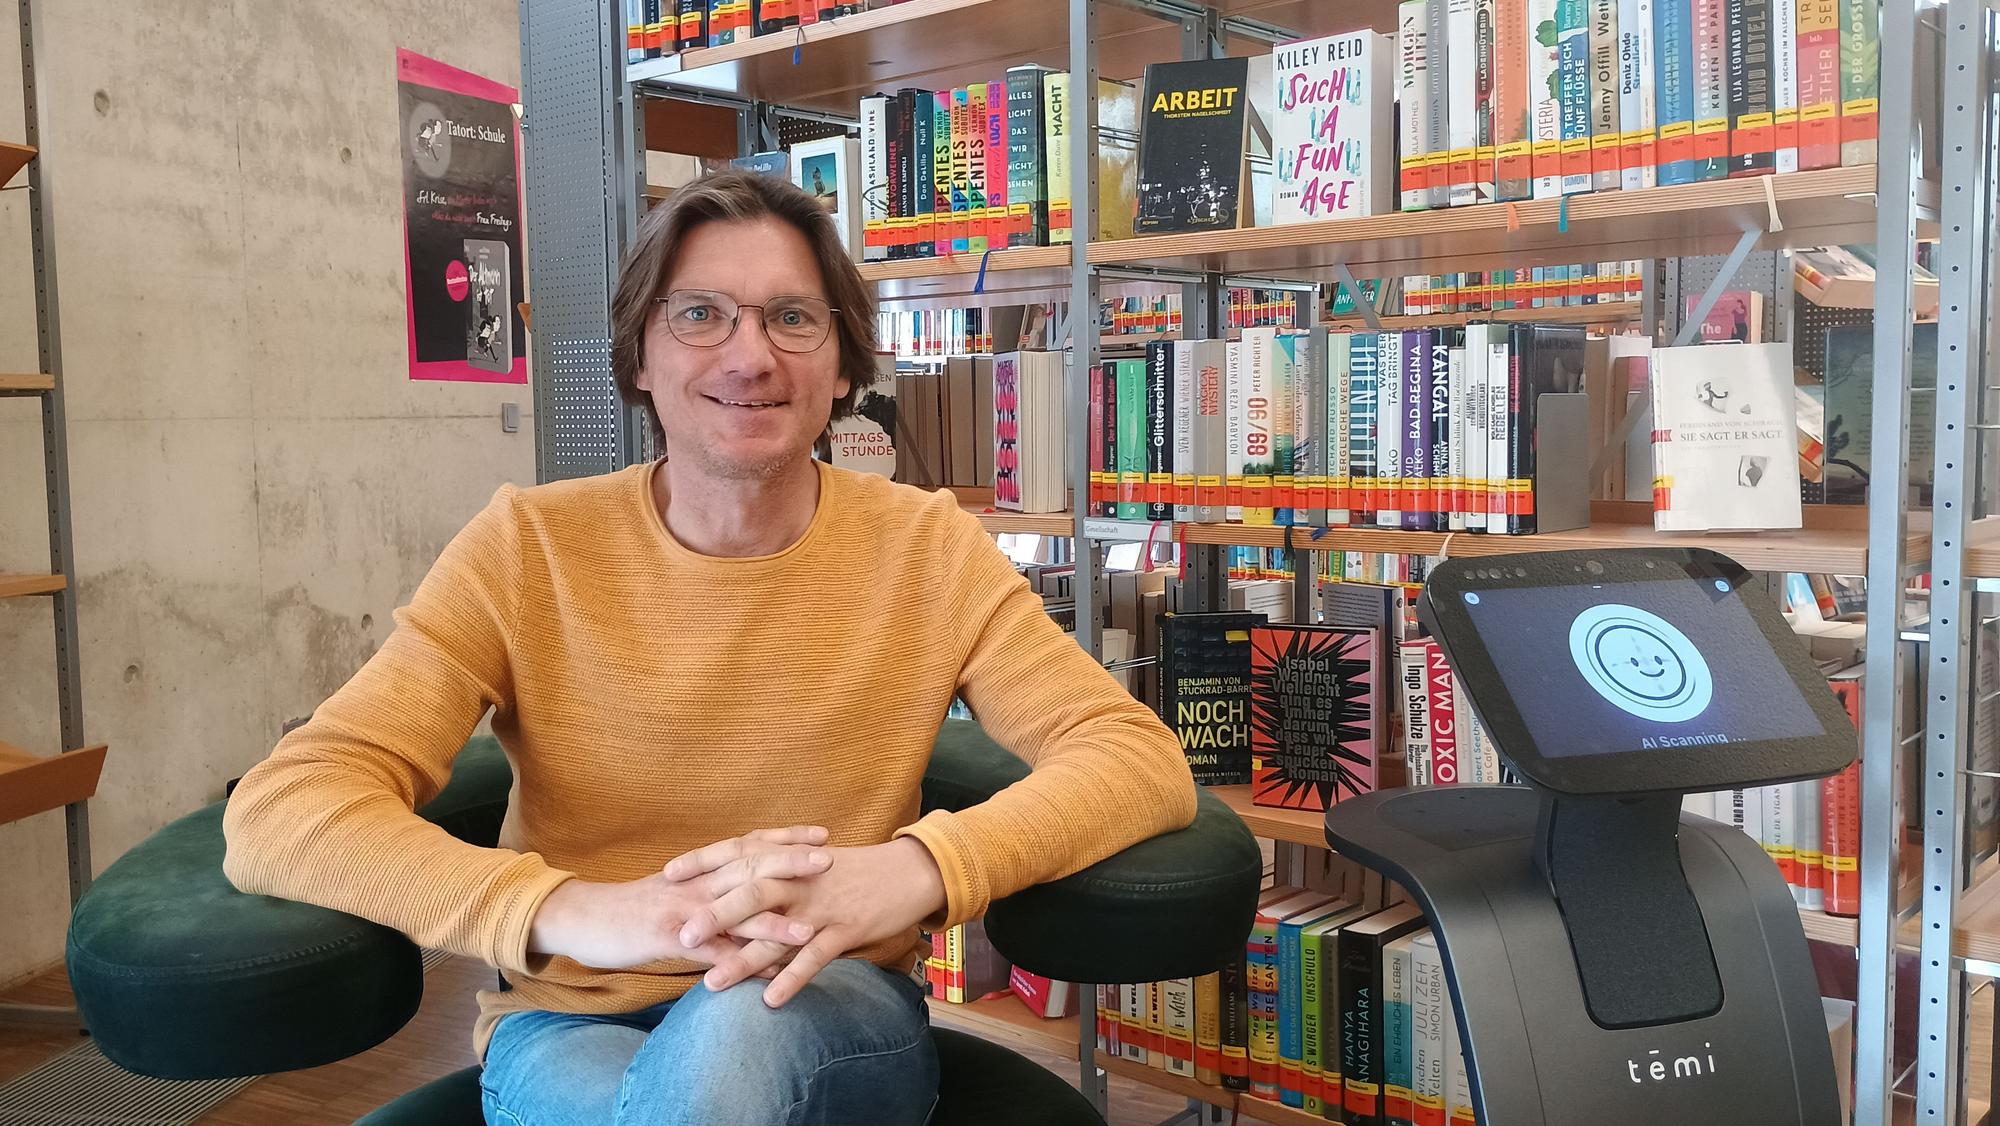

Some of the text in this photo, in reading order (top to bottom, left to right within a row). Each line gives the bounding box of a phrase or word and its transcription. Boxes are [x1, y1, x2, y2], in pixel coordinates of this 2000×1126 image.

[1277, 38, 1364, 71] KILEY REID
[1403, 17, 1415, 88] MORGEN
[1479, 13, 1488, 80] LADENHÜTERIN
[1598, 46, 1611, 83] Offill
[1622, 32, 1632, 95] Deniz Ohde
[1731, 29, 1742, 102] ILJA LEONARD
[1562, 42, 1573, 126] TREFFEN SICH
[1700, 42, 1709, 116] CHRISTOPH
[1709, 34, 1720, 109] KRÄHEN IM
[1801, 73, 1813, 106] TILL
[1852, 58, 1864, 84] DER
[1008, 92, 1033, 101] ALLES
[1008, 109, 1033, 119] LICHT
[1051, 85, 1063, 137] MACHT
[1151, 86, 1238, 113] ARBEIT
[1573, 58, 1586, 139] FÜNF FLÜSSE
[1599, 89, 1614, 130] Jenny
[446, 119, 507, 144] Tatort: Schule
[1011, 128, 1028, 136] DAS
[1319, 105, 1340, 144] A
[868, 138, 877, 185] ASHLAND
[888, 140, 897, 198] VORWEINER
[1011, 145, 1028, 154] WIR
[1300, 177, 1355, 215] AGE
[1700, 323, 1722, 336] The
[1378, 335, 1387, 389] WAS DER
[1388, 335, 1398, 407] TAG BRINGT
[1409, 345, 1421, 404] REGINA
[1153, 347, 1165, 447] Glitterschnitter
[1177, 350, 1191, 454] SVEN REGENER WIENER STRASSE
[1199, 368, 1209, 416] MAGICAL
[1208, 366, 1219, 416] MYSTERY
[1229, 346, 1239, 456] YASMINA REZA BABYLON
[1246, 335, 1268, 457] 89/90 PETER RICHTER
[1339, 371, 1348, 405] WEGE
[1432, 344, 1448, 422] KANGAL
[1295, 403, 1303, 441] Verfahren
[1409, 408, 1421, 440] BAD
[1495, 385, 1506, 441] REBELLEN
[829, 432, 884, 444] MITTAGS
[841, 445, 893, 457] STUNDE
[1440, 439, 1449, 464] ANNA
[1680, 430, 1750, 442] SIE ER
[1177, 676, 1241, 687] BENJAMIN VON
[1285, 655, 1329, 672] Isabel
[1272, 677, 1341, 697] Vielleicht
[1280, 694, 1333, 709] ging es
[1404, 664, 1429, 740] Ingo Schulze
[1177, 699, 1244, 725] NOCH
[1431, 653, 1456, 783] OXIC MAN
[1177, 724, 1248, 750] WACH
[1276, 728, 1308, 744] dass
[1286, 742, 1327, 758] Feuer
[1641, 731, 1729, 749] AI Scanning
[1186, 753, 1218, 766] OMAN
[1277, 754, 1337, 771] spucken
[1288, 765, 1338, 782] Roman
[1474, 756, 1483, 783] obert
[1264, 935, 1276, 1045] INTERESSANTEN
[1304, 947, 1316, 1003] UNSCHULD
[1392, 958, 1401, 991] LEBEN
[1392, 991, 1402, 1048] EHRLICHES
[1415, 962, 1428, 1040] JULI ZEH
[1429, 965, 1441, 1042] SIMON URBAN
[1344, 1010, 1354, 1067] HANYA
[1357, 987, 1370, 1081] ANAGIHARA
[1415, 1049, 1426, 1097] wischen
[1626, 1042, 1715, 1084] tēmi
